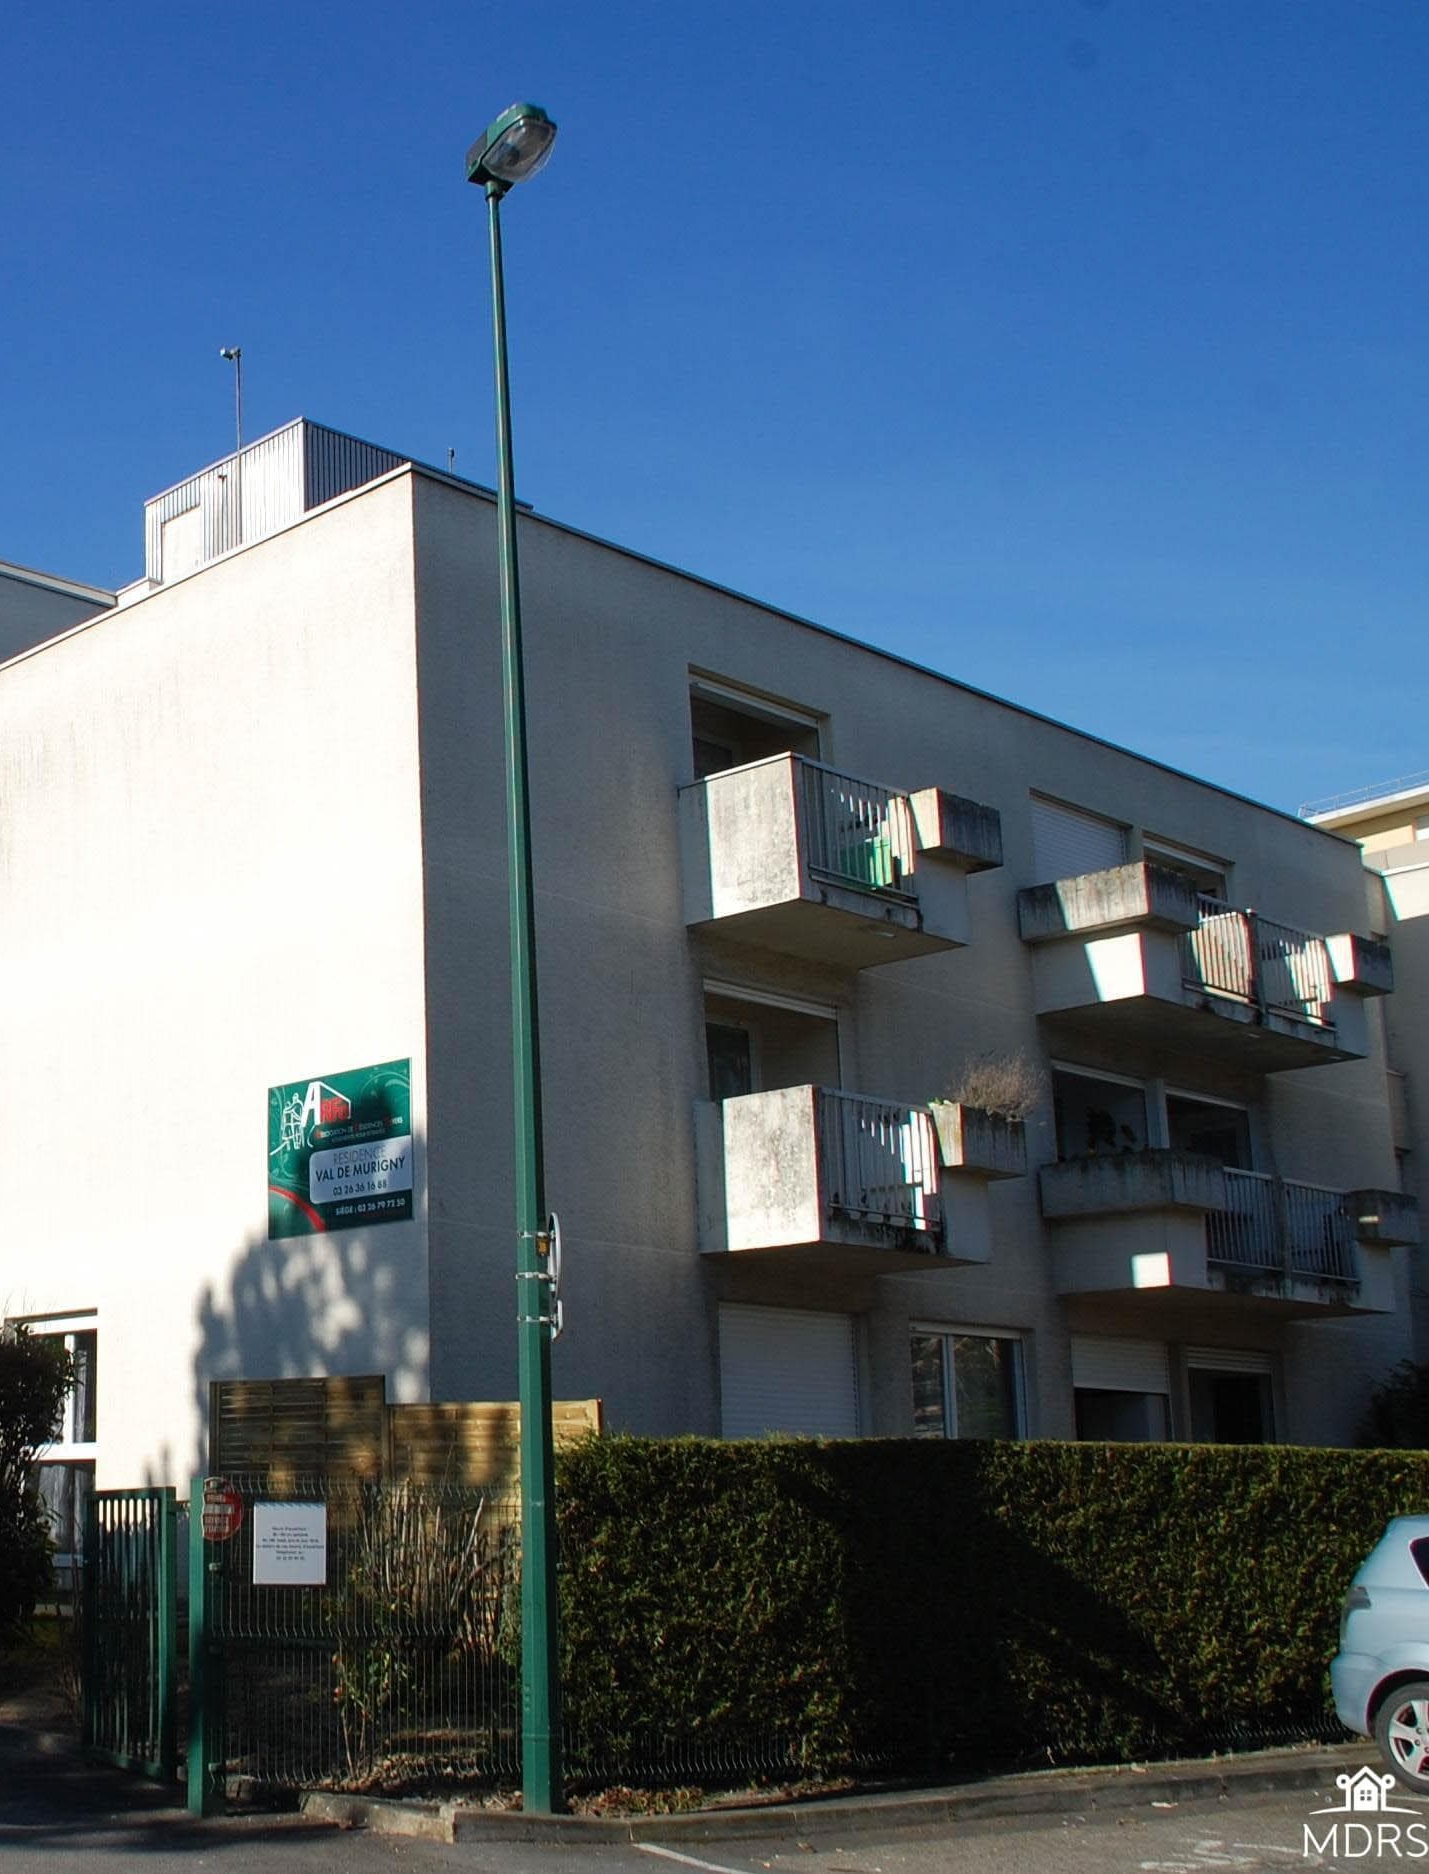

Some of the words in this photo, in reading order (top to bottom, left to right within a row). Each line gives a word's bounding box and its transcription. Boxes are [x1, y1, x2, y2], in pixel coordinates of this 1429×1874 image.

[316, 1168, 334, 1182] VAL
[337, 1166, 350, 1179] DE
[353, 1156, 405, 1176] MURIGNY
[333, 1186, 342, 1196] 03
[345, 1185, 354, 1194] 26
[355, 1183, 365, 1193] 36
[367, 1181, 376, 1191] 16
